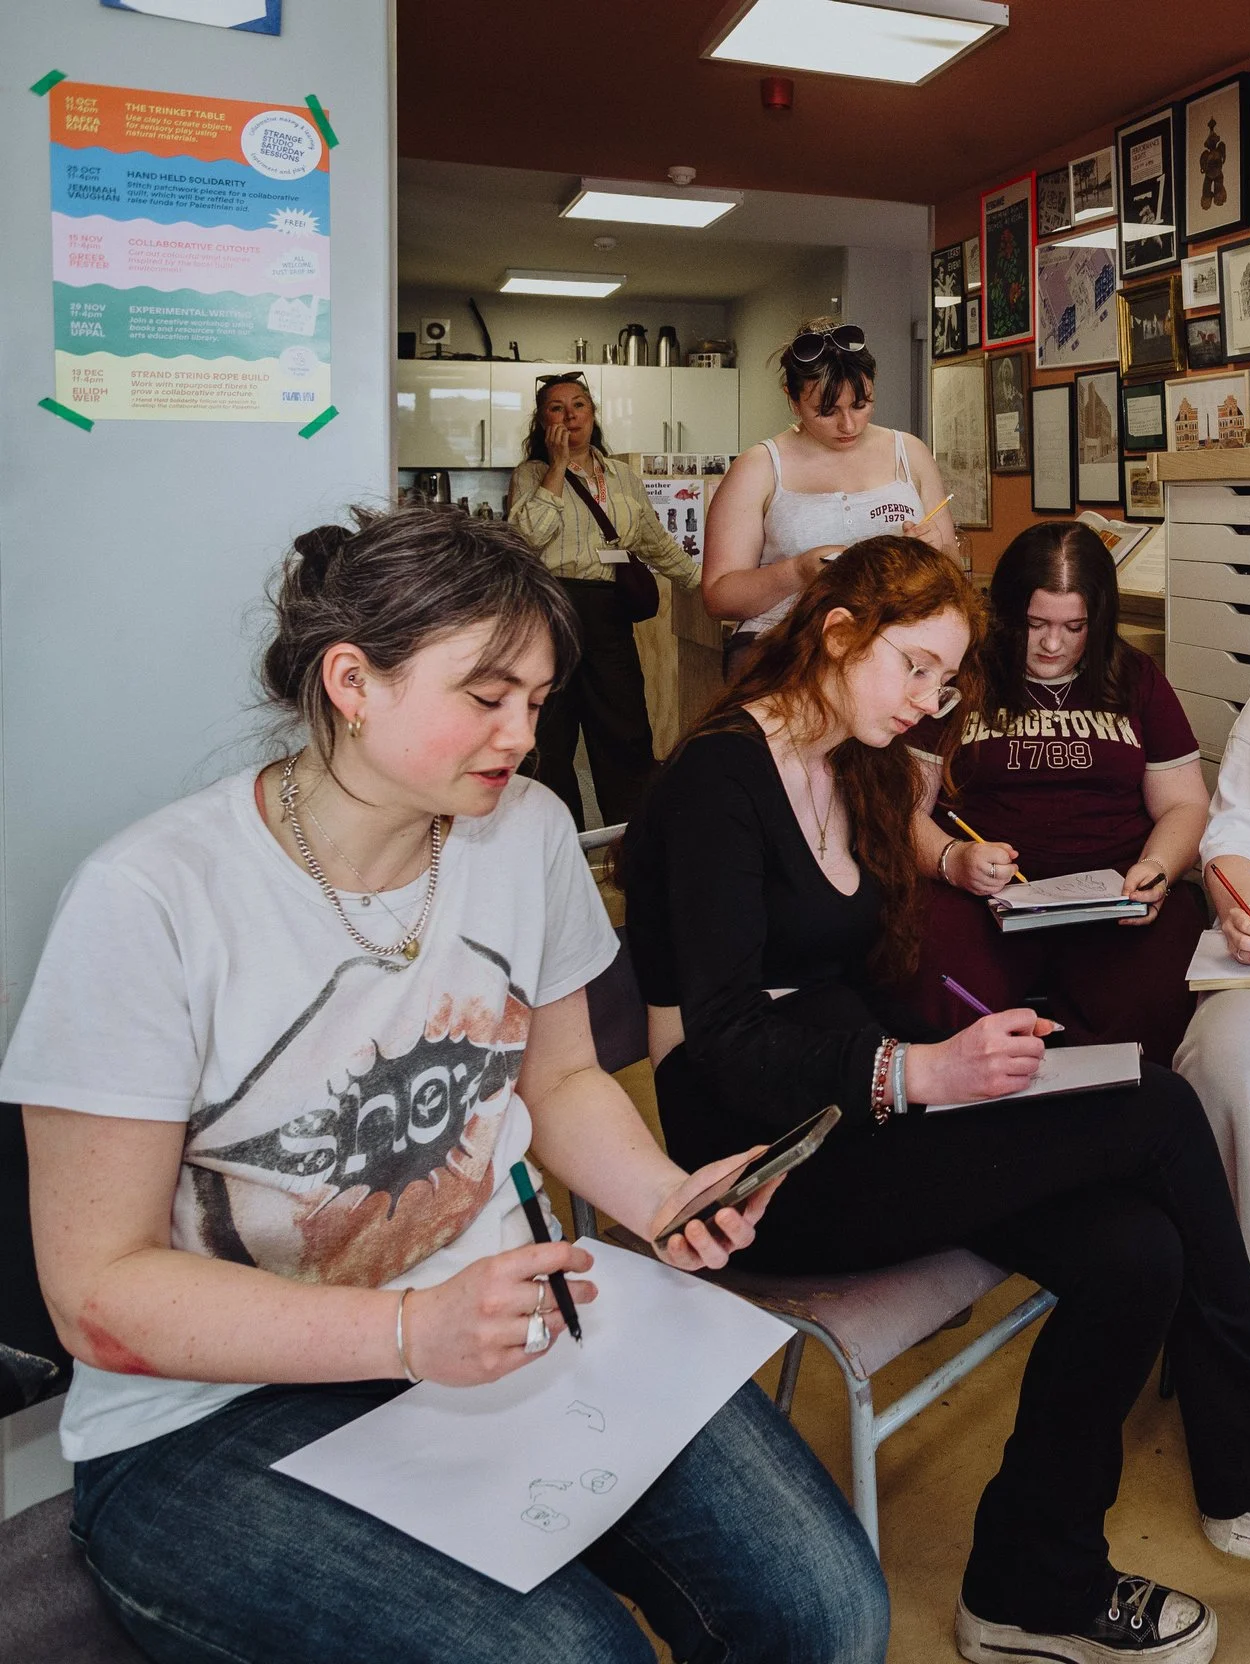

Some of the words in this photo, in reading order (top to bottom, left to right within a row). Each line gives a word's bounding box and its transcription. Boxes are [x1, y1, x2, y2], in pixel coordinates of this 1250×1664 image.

[77, 97, 97, 106] OCT
[125, 103, 147, 113] THE
[148, 105, 192, 117] TRINKET
[195, 111, 226, 121] TABLE
[66, 122, 99, 133] KHAN
[126, 114, 142, 122] Use
[144, 117, 162, 125] clay
[174, 120, 200, 128] create
[202, 122, 232, 132] objects
[126, 121, 138, 129] for
[140, 124, 173, 134] sensory
[175, 127, 193, 137] play
[195, 129, 218, 138] using
[126, 129, 156, 138] natural
[158, 132, 198, 142] materials.
[262, 136, 293, 148] STUDIO
[264, 129, 303, 144] STRANGE
[261, 142, 304, 157] SATURDAY
[260, 149, 300, 163] SESSIONS
[80, 166, 101, 175] OCT
[127, 170, 158, 180] HAND
[160, 173, 187, 183] HELD
[188, 176, 246, 188] SOLIDARITY
[68, 183, 117, 195] JEMIMAH
[127, 181, 152, 190] Stitch
[154, 184, 199, 195] patchwork
[200, 187, 226, 196] pieces
[228, 189, 241, 197] for
[249, 191, 300, 202] collaborative
[68, 191, 120, 203] VAUGHAN
[151, 192, 177, 200] which
[179, 193, 193, 201] will
[195, 194, 206, 202] be
[127, 197, 148, 205] raise
[149, 199, 174, 207] funds
[176, 200, 187, 208] for
[189, 201, 234, 211] Palestinian
[81, 235, 103, 243] NOV
[128, 238, 212, 251] COLLABORATIVE
[215, 244, 261, 254] CUTOUTS
[70, 260, 110, 269] PESTER
[178, 259, 191, 267] the
[84, 303, 106, 311] NOV
[129, 306, 206, 316] EXPERIMENTAL
[209, 309, 253, 318] WRITING
[70, 321, 102, 330] MAYA
[129, 316, 147, 324] Join
[155, 318, 189, 326] creative
[190, 319, 230, 328] workshop
[232, 321, 254, 330] using
[70, 328, 106, 338] UPPAL
[157, 325, 174, 333] and
[216, 327, 237, 335] from
[147, 332, 189, 340] education
[191, 333, 220, 342] library.
[84, 369, 104, 377] DEC
[130, 370, 172, 379] STRAND
[174, 371, 211, 380] STRING
[213, 373, 239, 381] ROPE
[241, 374, 270, 382] BUILD
[72, 387, 109, 395] EILIDH
[154, 380, 173, 388] with
[175, 382, 223, 391] repurposed
[224, 382, 248, 390] fibres
[72, 394, 101, 402] WEIR
[161, 388, 214, 397] collaborative
[870, 503, 916, 519] SUPERDRY
[884, 513, 905, 523] 1979
[1007, 740, 1093, 770] 1789
